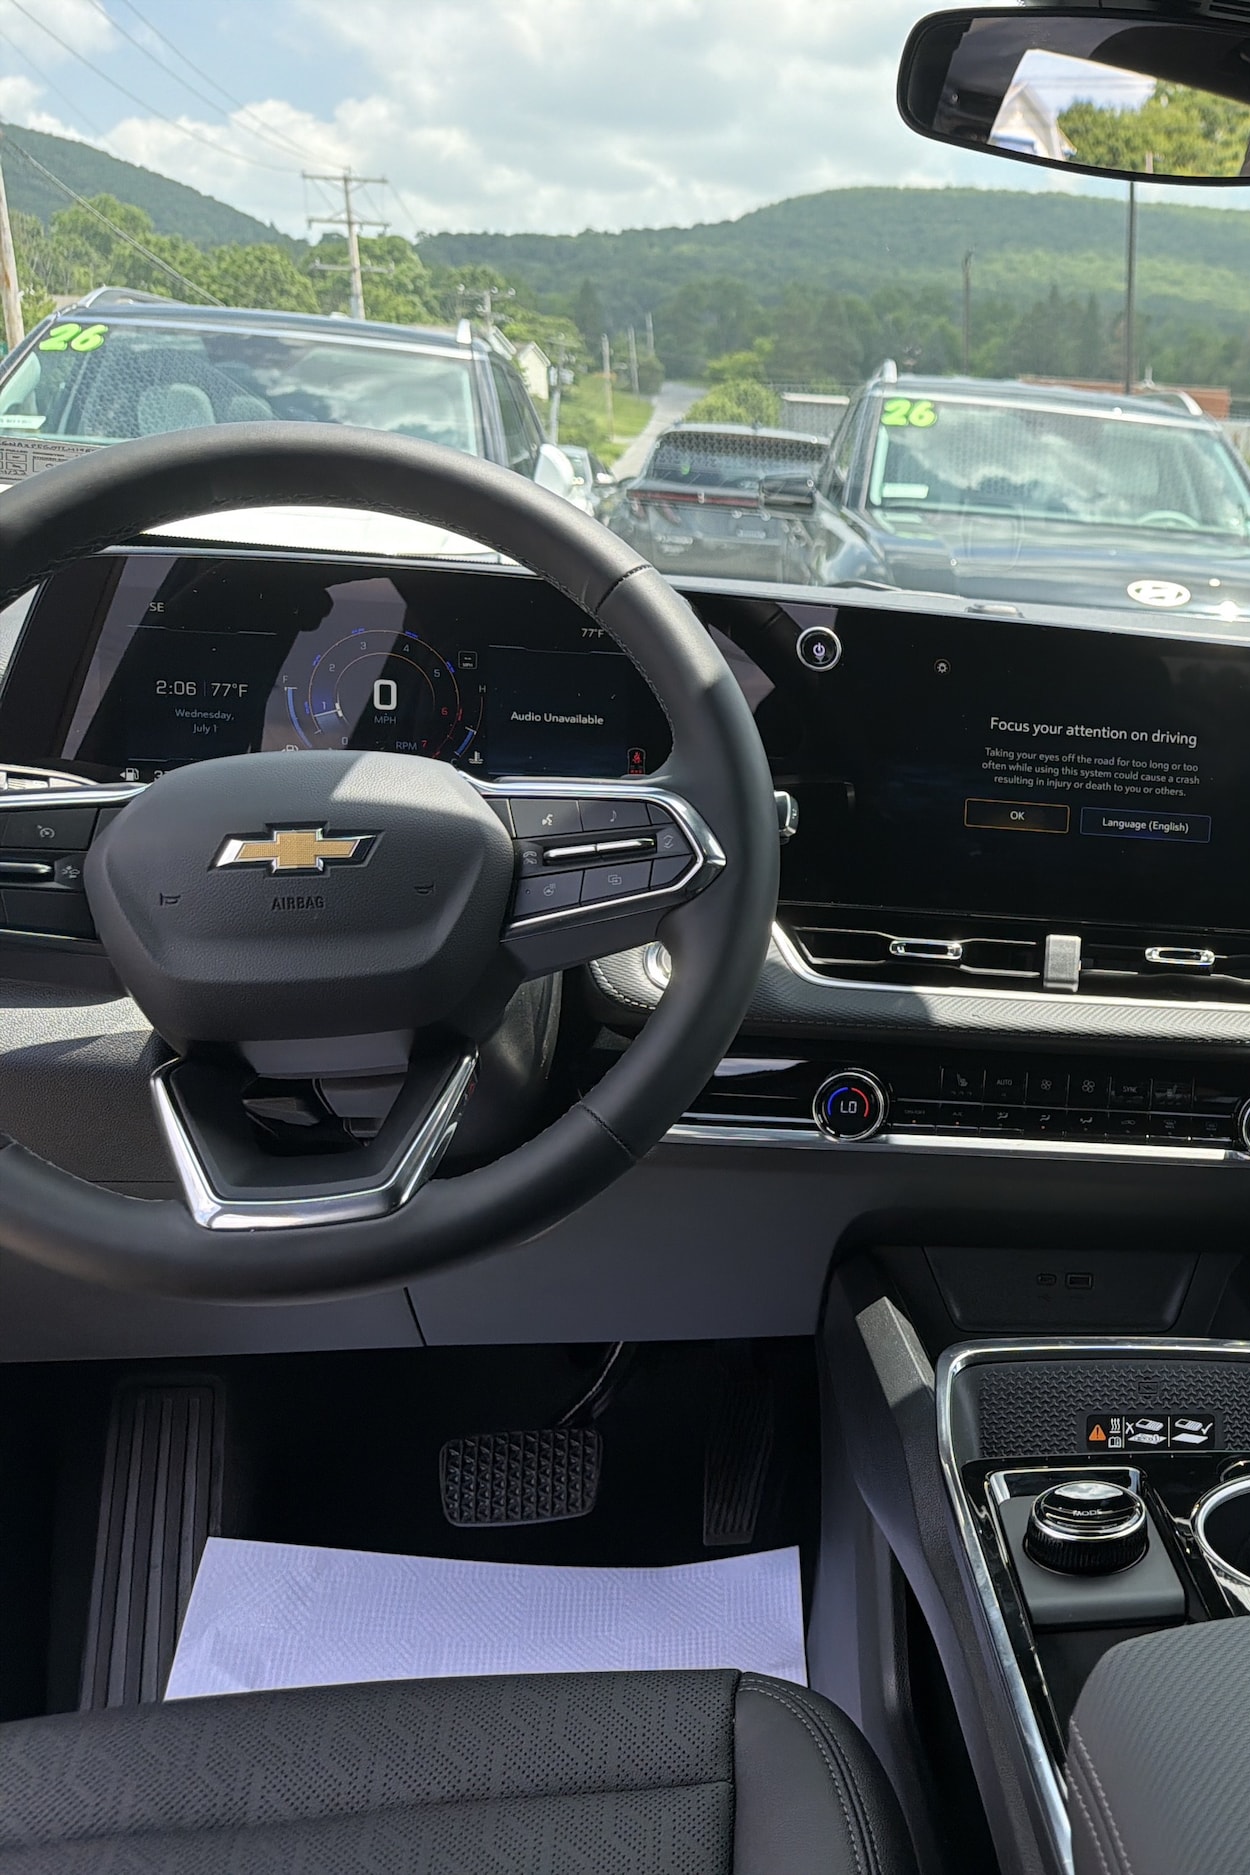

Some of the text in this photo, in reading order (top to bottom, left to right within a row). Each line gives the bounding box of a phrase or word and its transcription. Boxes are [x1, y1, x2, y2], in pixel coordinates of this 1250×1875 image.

[39, 323, 108, 351] 26
[881, 398, 937, 427] 26
[149, 602, 165, 613] SE
[360, 642, 367, 650] 3
[403, 644, 410, 653] 4
[329, 664, 335, 672] 2
[434, 669, 441, 678] 5
[283, 675, 288, 684] F
[156, 680, 249, 698] 2:06 77°F
[479, 685, 486, 693] H
[373, 679, 397, 711] 0
[322, 702, 326, 710] 1
[175, 708, 235, 721] Wednesday,
[441, 707, 448, 716] 6
[374, 715, 397, 724] MPH
[510, 711, 605, 725] Audio Unavailable
[192, 724, 218, 735] July 1
[990, 716, 1198, 748] Focus your attention on driving
[342, 737, 348, 746] 0
[396, 741, 417, 751] RPM
[985, 747, 1199, 772] Taking your eyes off the road for too long or too
[982, 760, 1007, 771] often
[1008, 762, 1033, 773] while
[1035, 765, 1060, 778] using
[1061, 765, 1078, 776] this
[1080, 768, 1112, 781] system
[1114, 769, 1139, 781] could
[1140, 772, 1166, 782] cause
[1175, 774, 1200, 785] crash
[994, 775, 1187, 797] resulting in injury or death to you or others.
[1010, 811, 1026, 821] OK
[1102, 817, 1189, 834] Language (English)
[271, 895, 324, 910] AIRBAG
[996, 1079, 1013, 1087] AUTO
[1072, 1508, 1103, 1517] MODE
